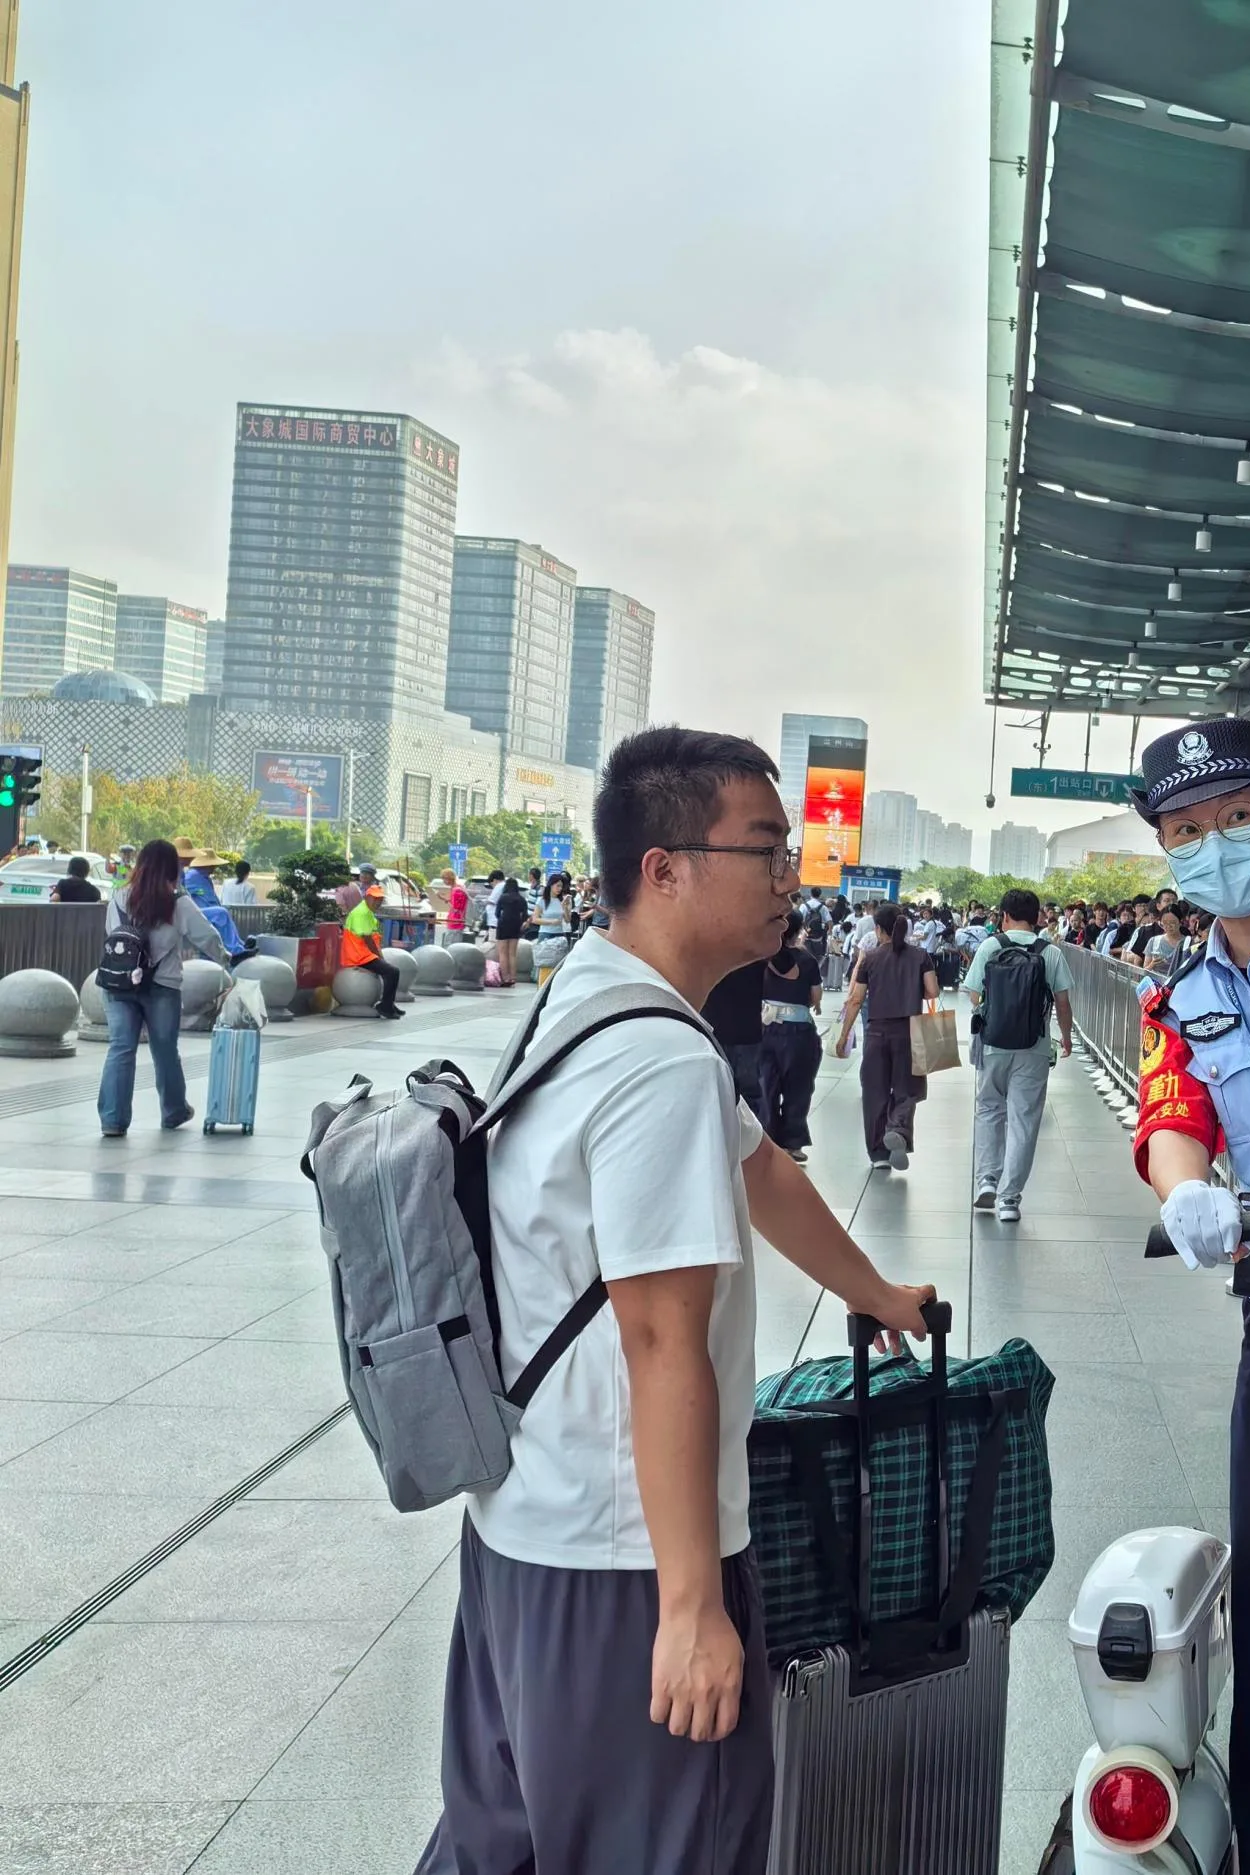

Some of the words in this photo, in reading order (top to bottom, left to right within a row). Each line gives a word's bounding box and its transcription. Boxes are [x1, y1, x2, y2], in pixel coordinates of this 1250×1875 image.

[246, 415, 394, 447] 大象城国际商贸中心
